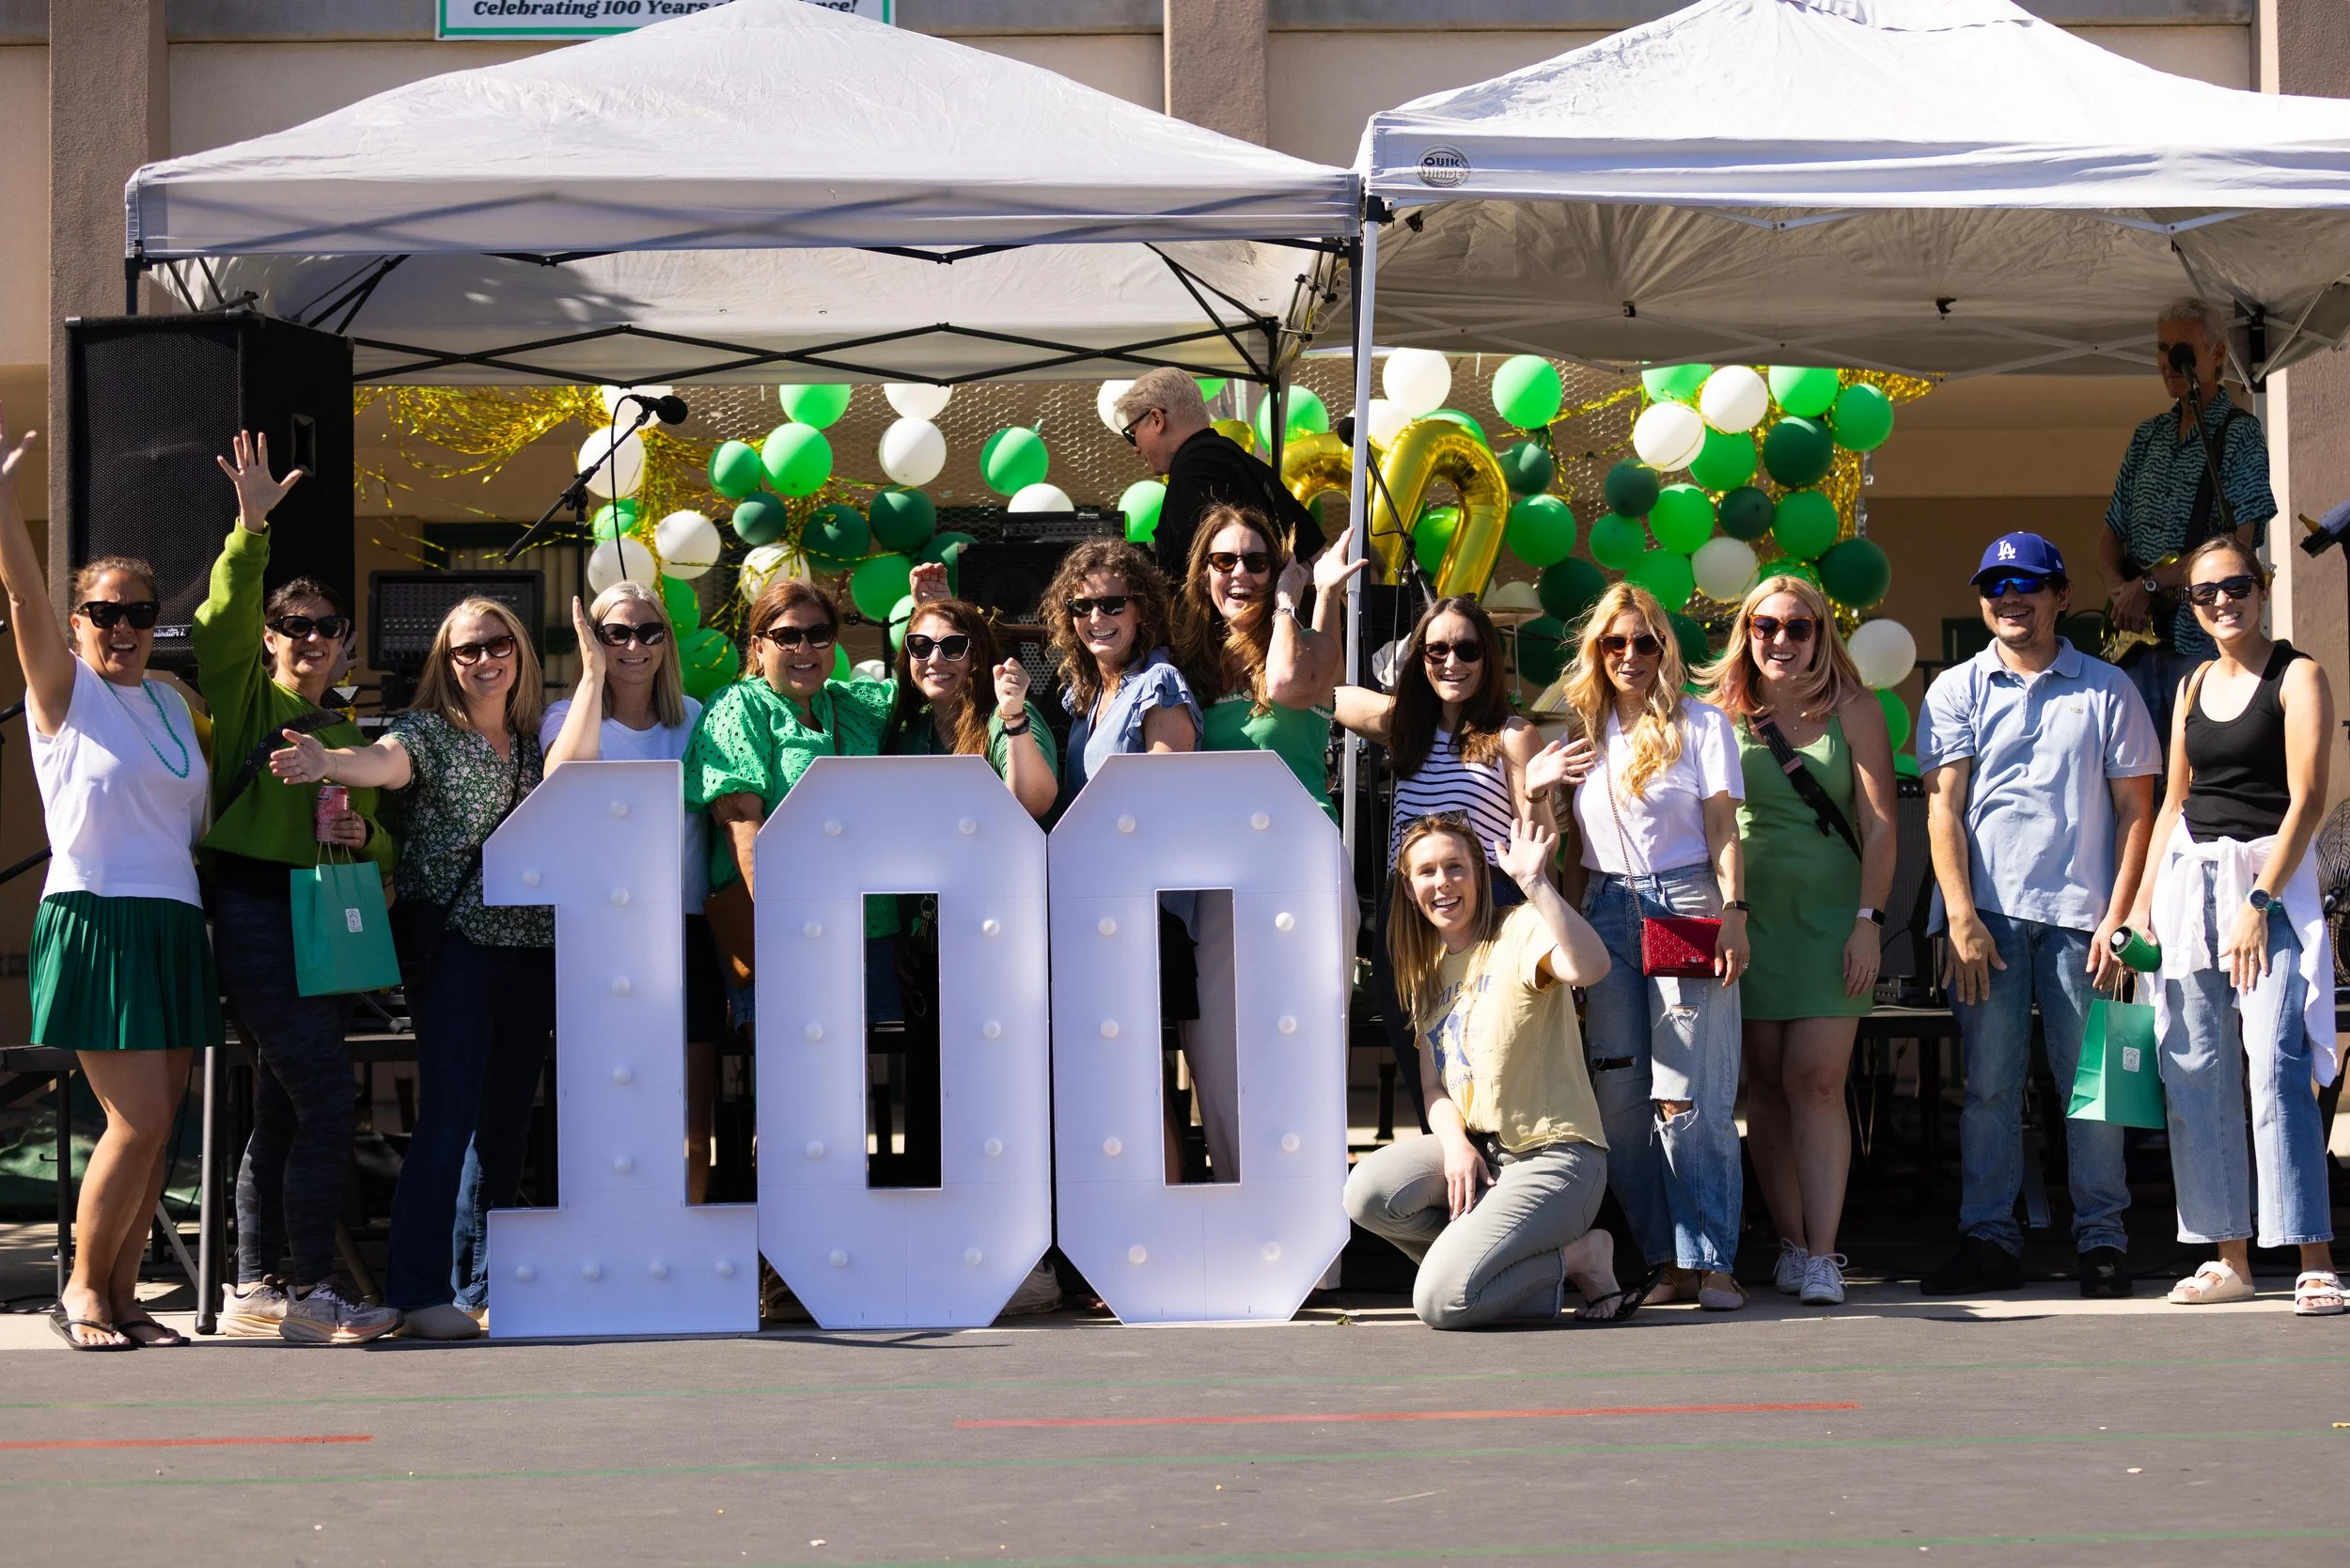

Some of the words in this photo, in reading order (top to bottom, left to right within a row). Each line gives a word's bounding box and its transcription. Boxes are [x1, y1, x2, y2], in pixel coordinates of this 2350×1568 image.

[474, 0, 601, 18] Celebrating
[603, 0, 641, 14] 100
[648, 0, 709, 14] Years
[1423, 156, 1460, 166] QUIK
[1998, 540, 2016, 561] LA
[483, 749, 1350, 1338] 100
[287, 1301, 312, 1318] HOKA
